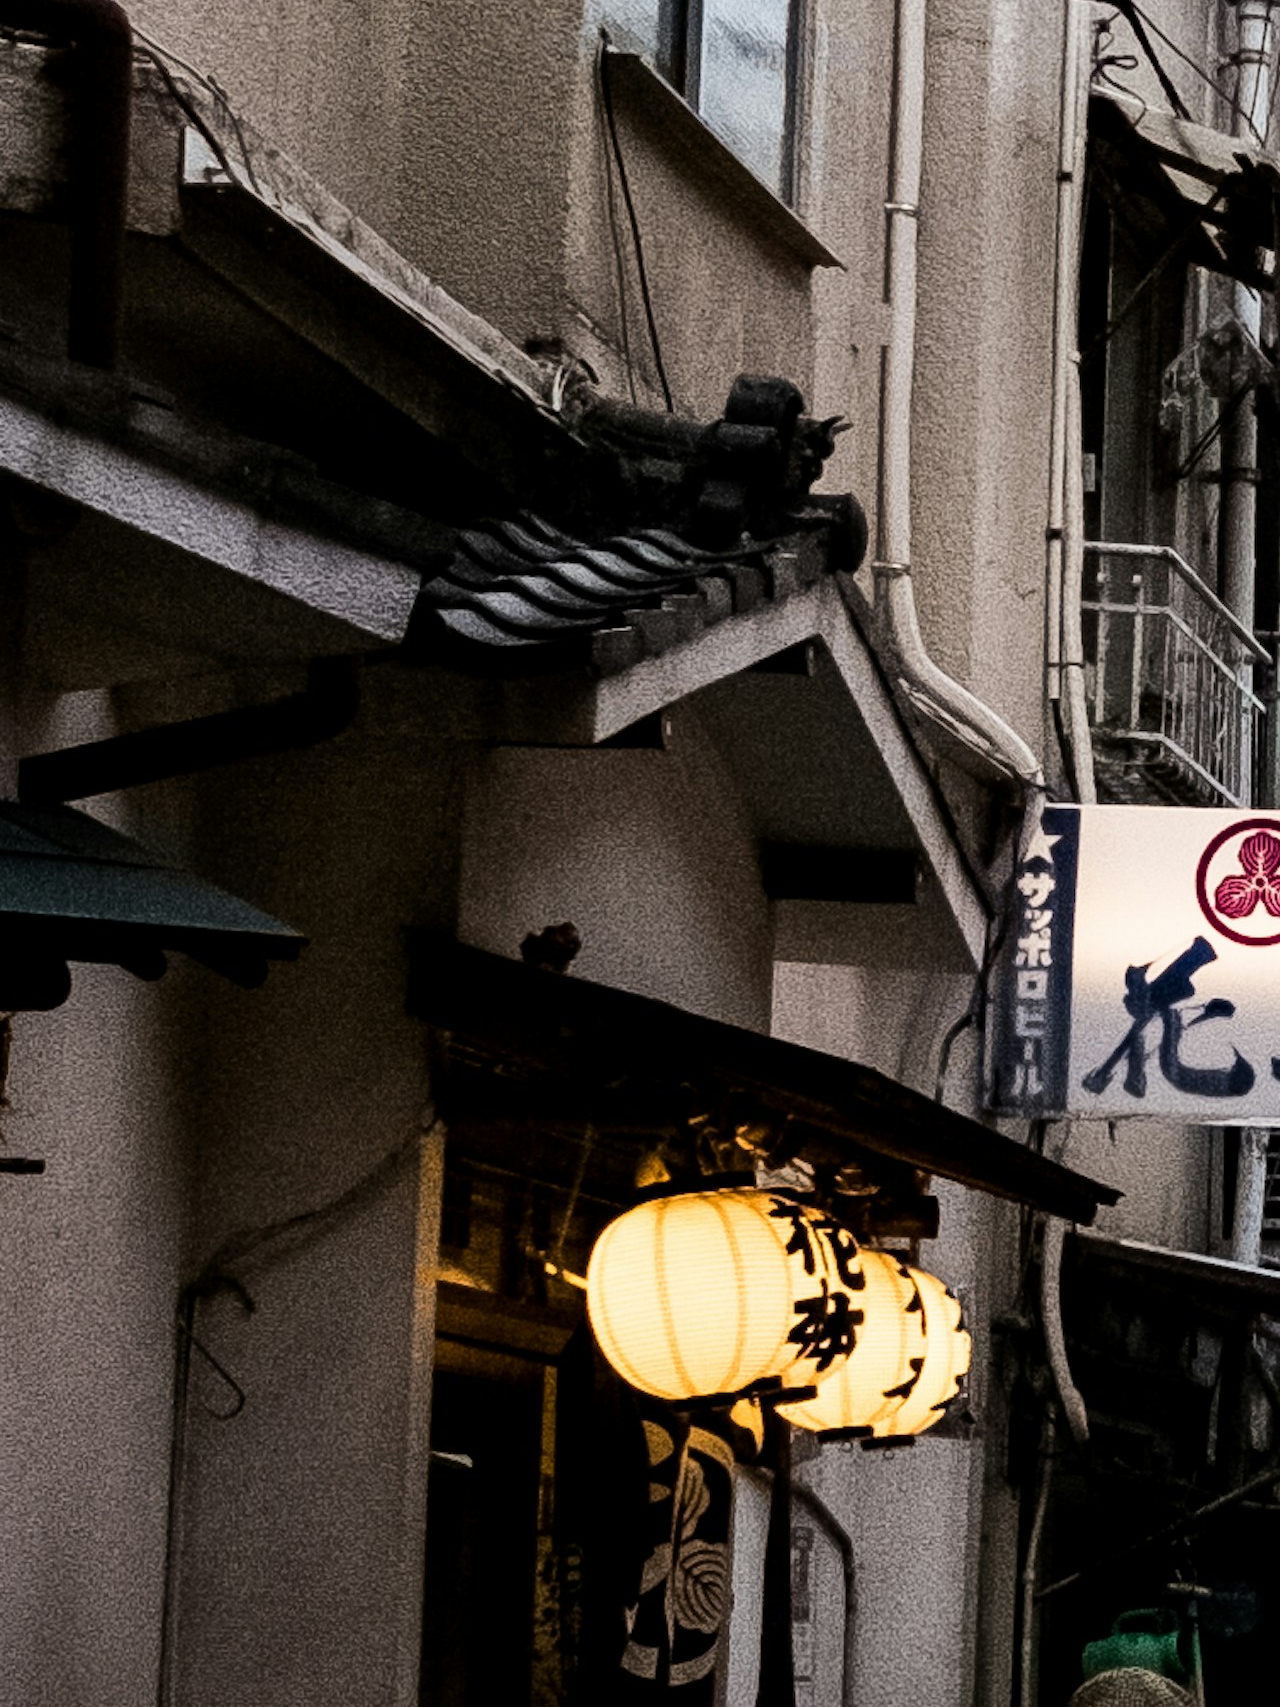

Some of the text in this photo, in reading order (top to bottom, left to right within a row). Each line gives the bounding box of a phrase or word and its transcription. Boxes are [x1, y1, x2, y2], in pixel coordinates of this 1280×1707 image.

[1013, 871, 1056, 1095] サッポロビール
